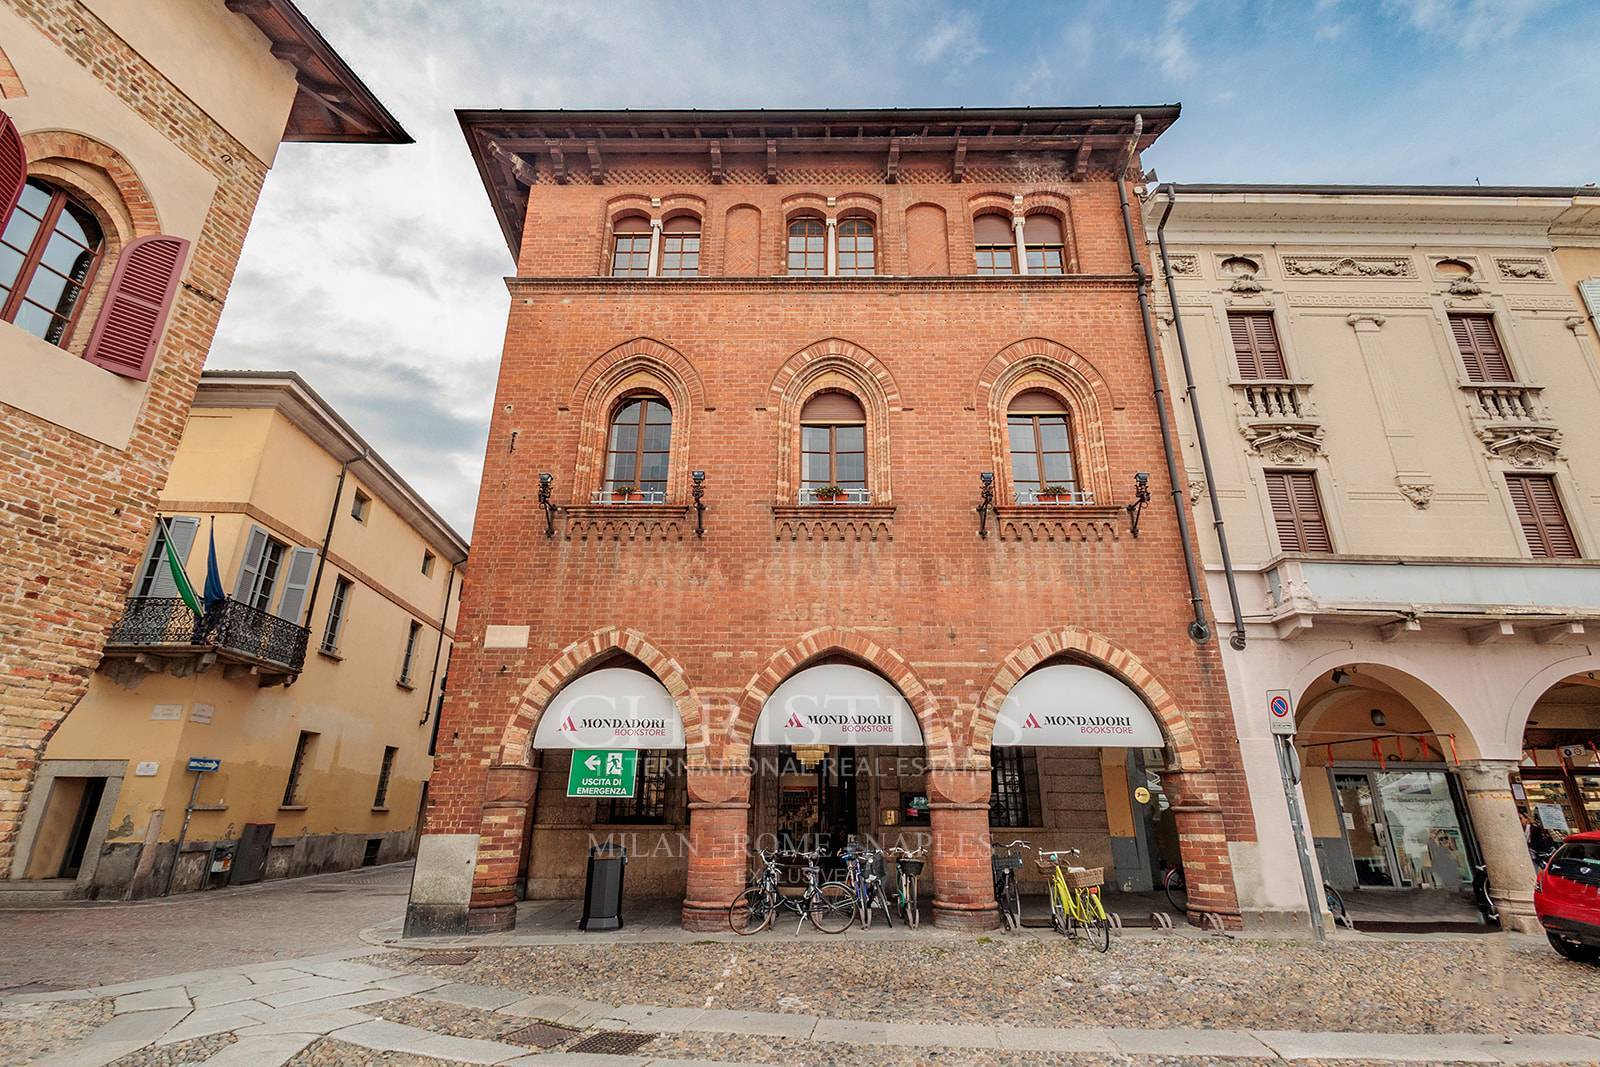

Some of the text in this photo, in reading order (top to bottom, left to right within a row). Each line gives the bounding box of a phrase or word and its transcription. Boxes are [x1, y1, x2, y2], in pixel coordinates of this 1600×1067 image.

[807, 714, 892, 725] MONDADORI
[1044, 715, 1131, 726] MONDADORI
[581, 719, 665, 729] MONDADORI
[614, 729, 666, 737] BOOKSTORE
[841, 725, 893, 733] BOOKSTORE
[1080, 726, 1133, 735] BOOKSTORE
[582, 778, 622, 786] USCITA DI
[576, 787, 627, 795] EMERGENZA
